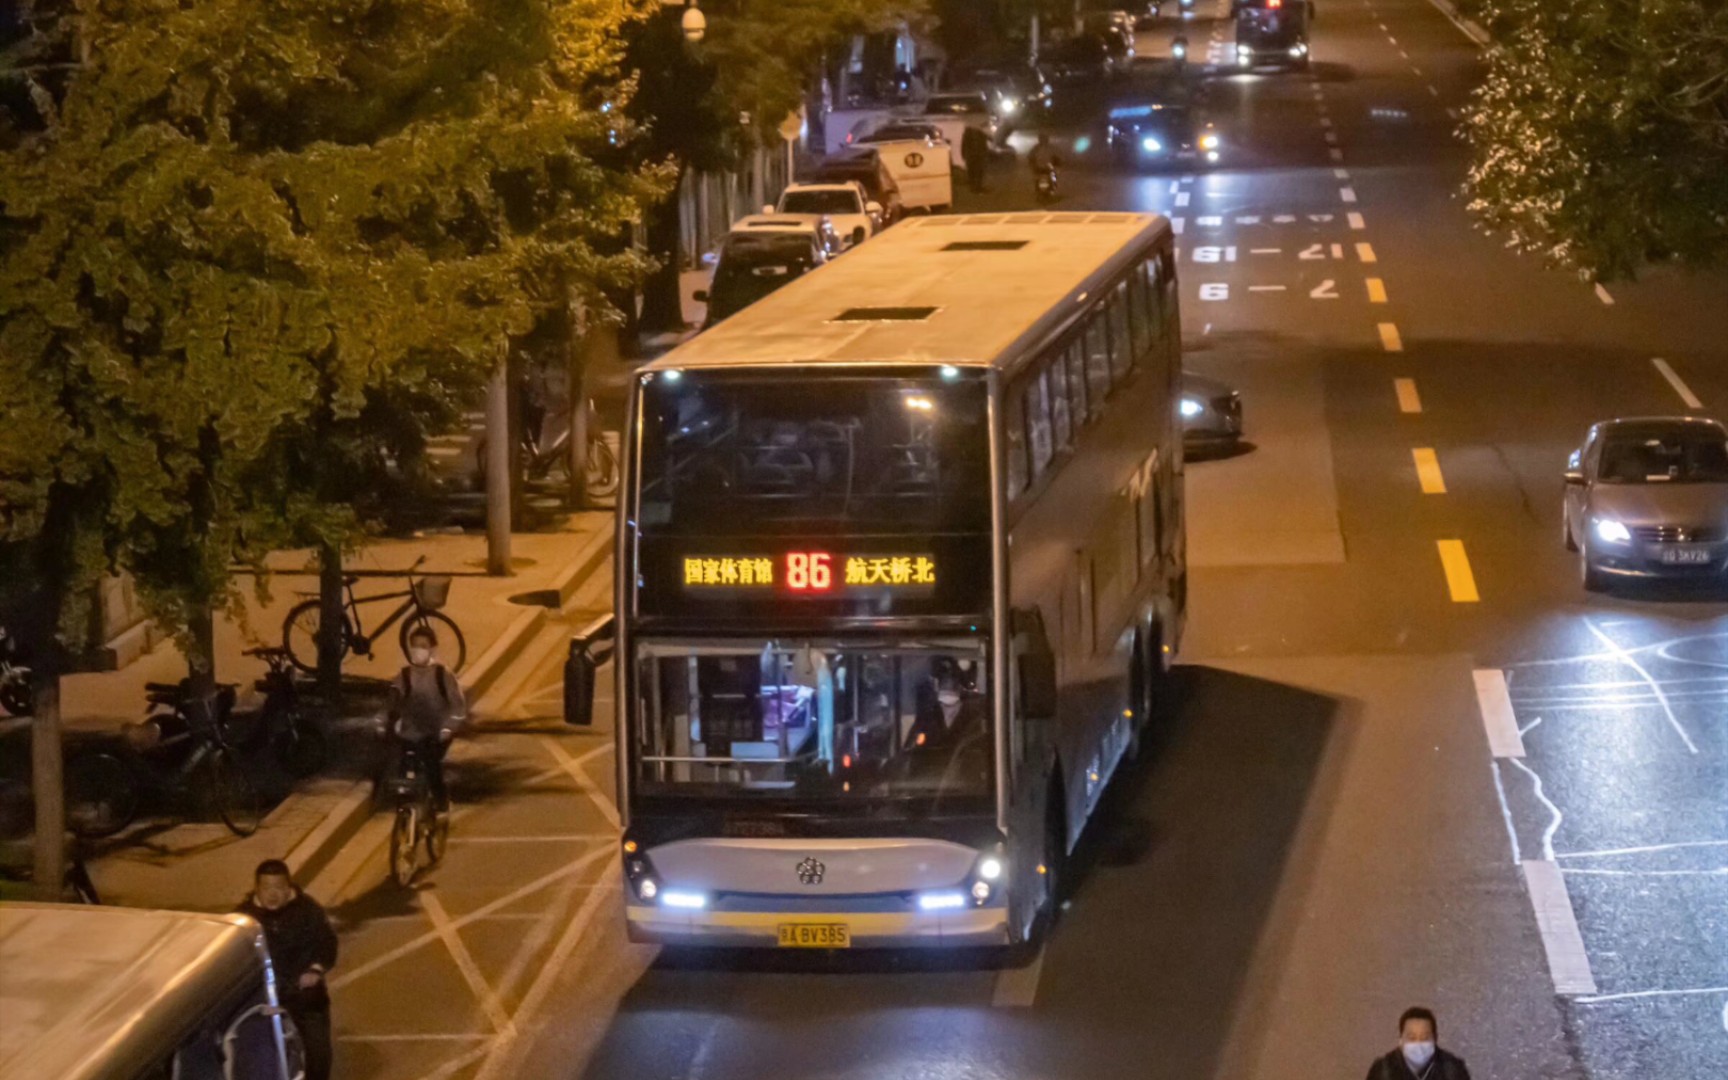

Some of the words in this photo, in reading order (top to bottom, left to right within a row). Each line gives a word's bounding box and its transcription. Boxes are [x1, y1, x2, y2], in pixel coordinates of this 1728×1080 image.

[684, 557, 773, 584] 国家体育馆
[787, 553, 831, 589] 86
[844, 556, 936, 584] 航天桥北
